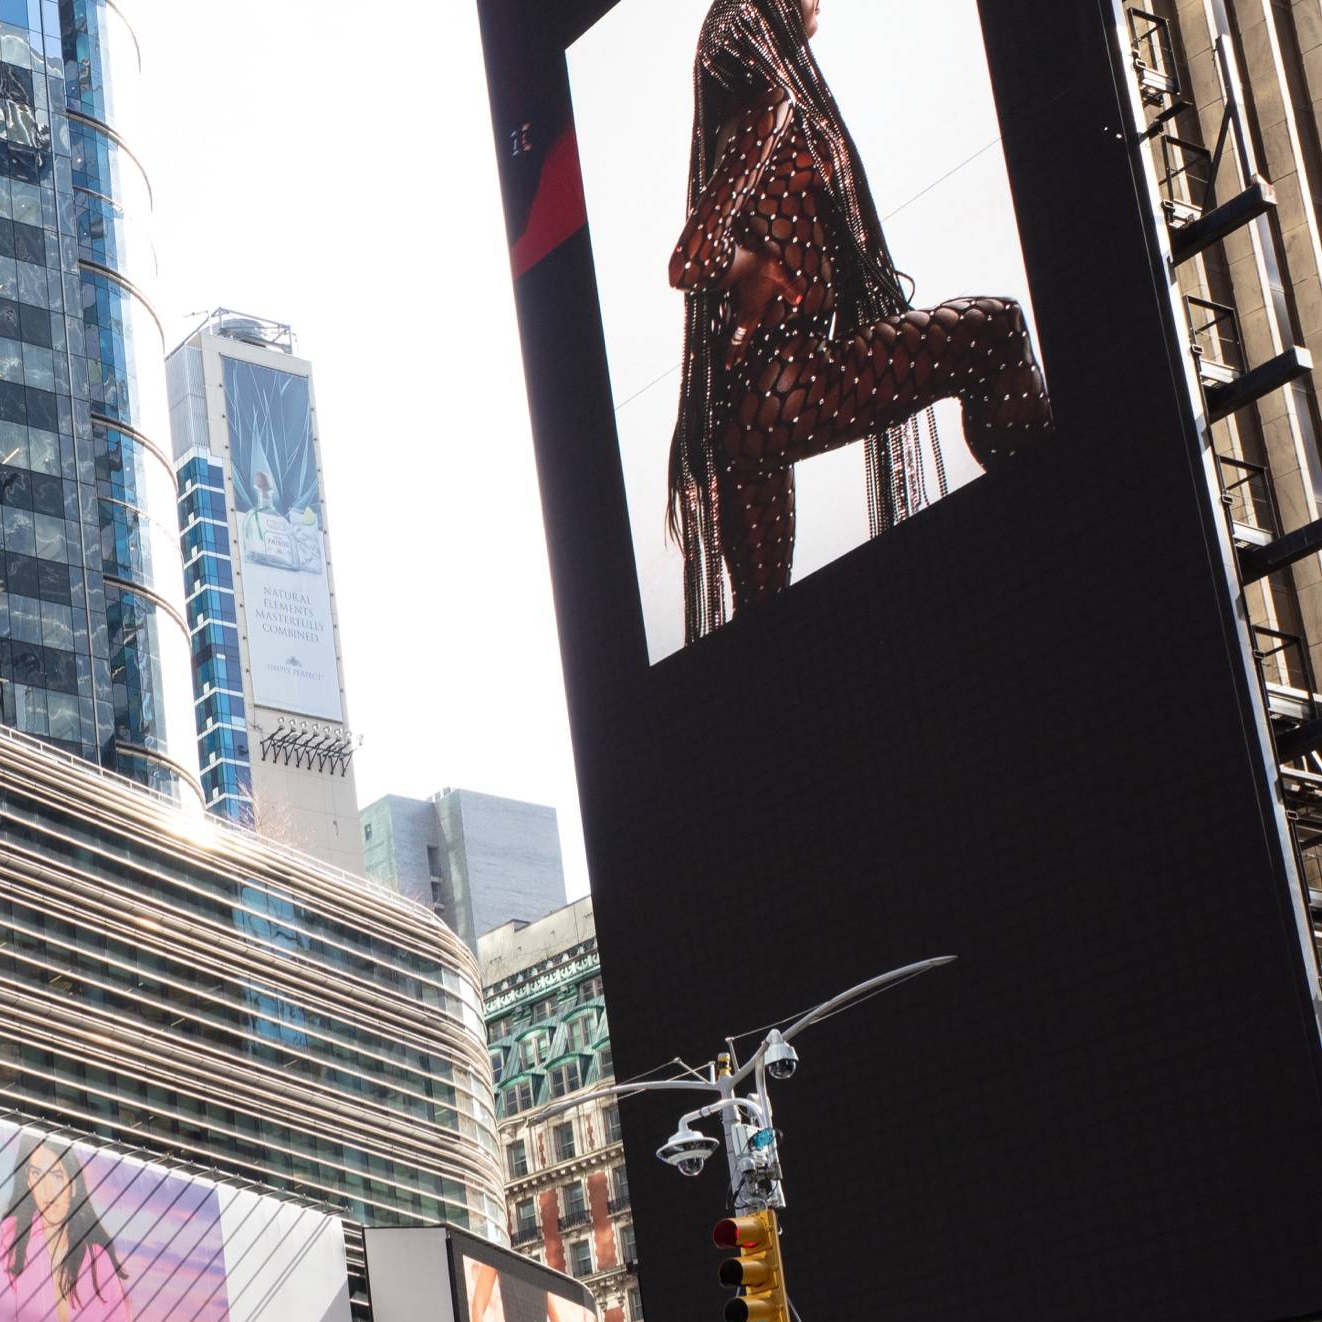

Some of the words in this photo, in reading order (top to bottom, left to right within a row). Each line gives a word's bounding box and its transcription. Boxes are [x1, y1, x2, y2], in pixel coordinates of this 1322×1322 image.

[263, 587, 311, 605] NATURAL
[263, 599, 314, 617] ELEMENTS
[255, 609, 325, 632] MASTERFULLY
